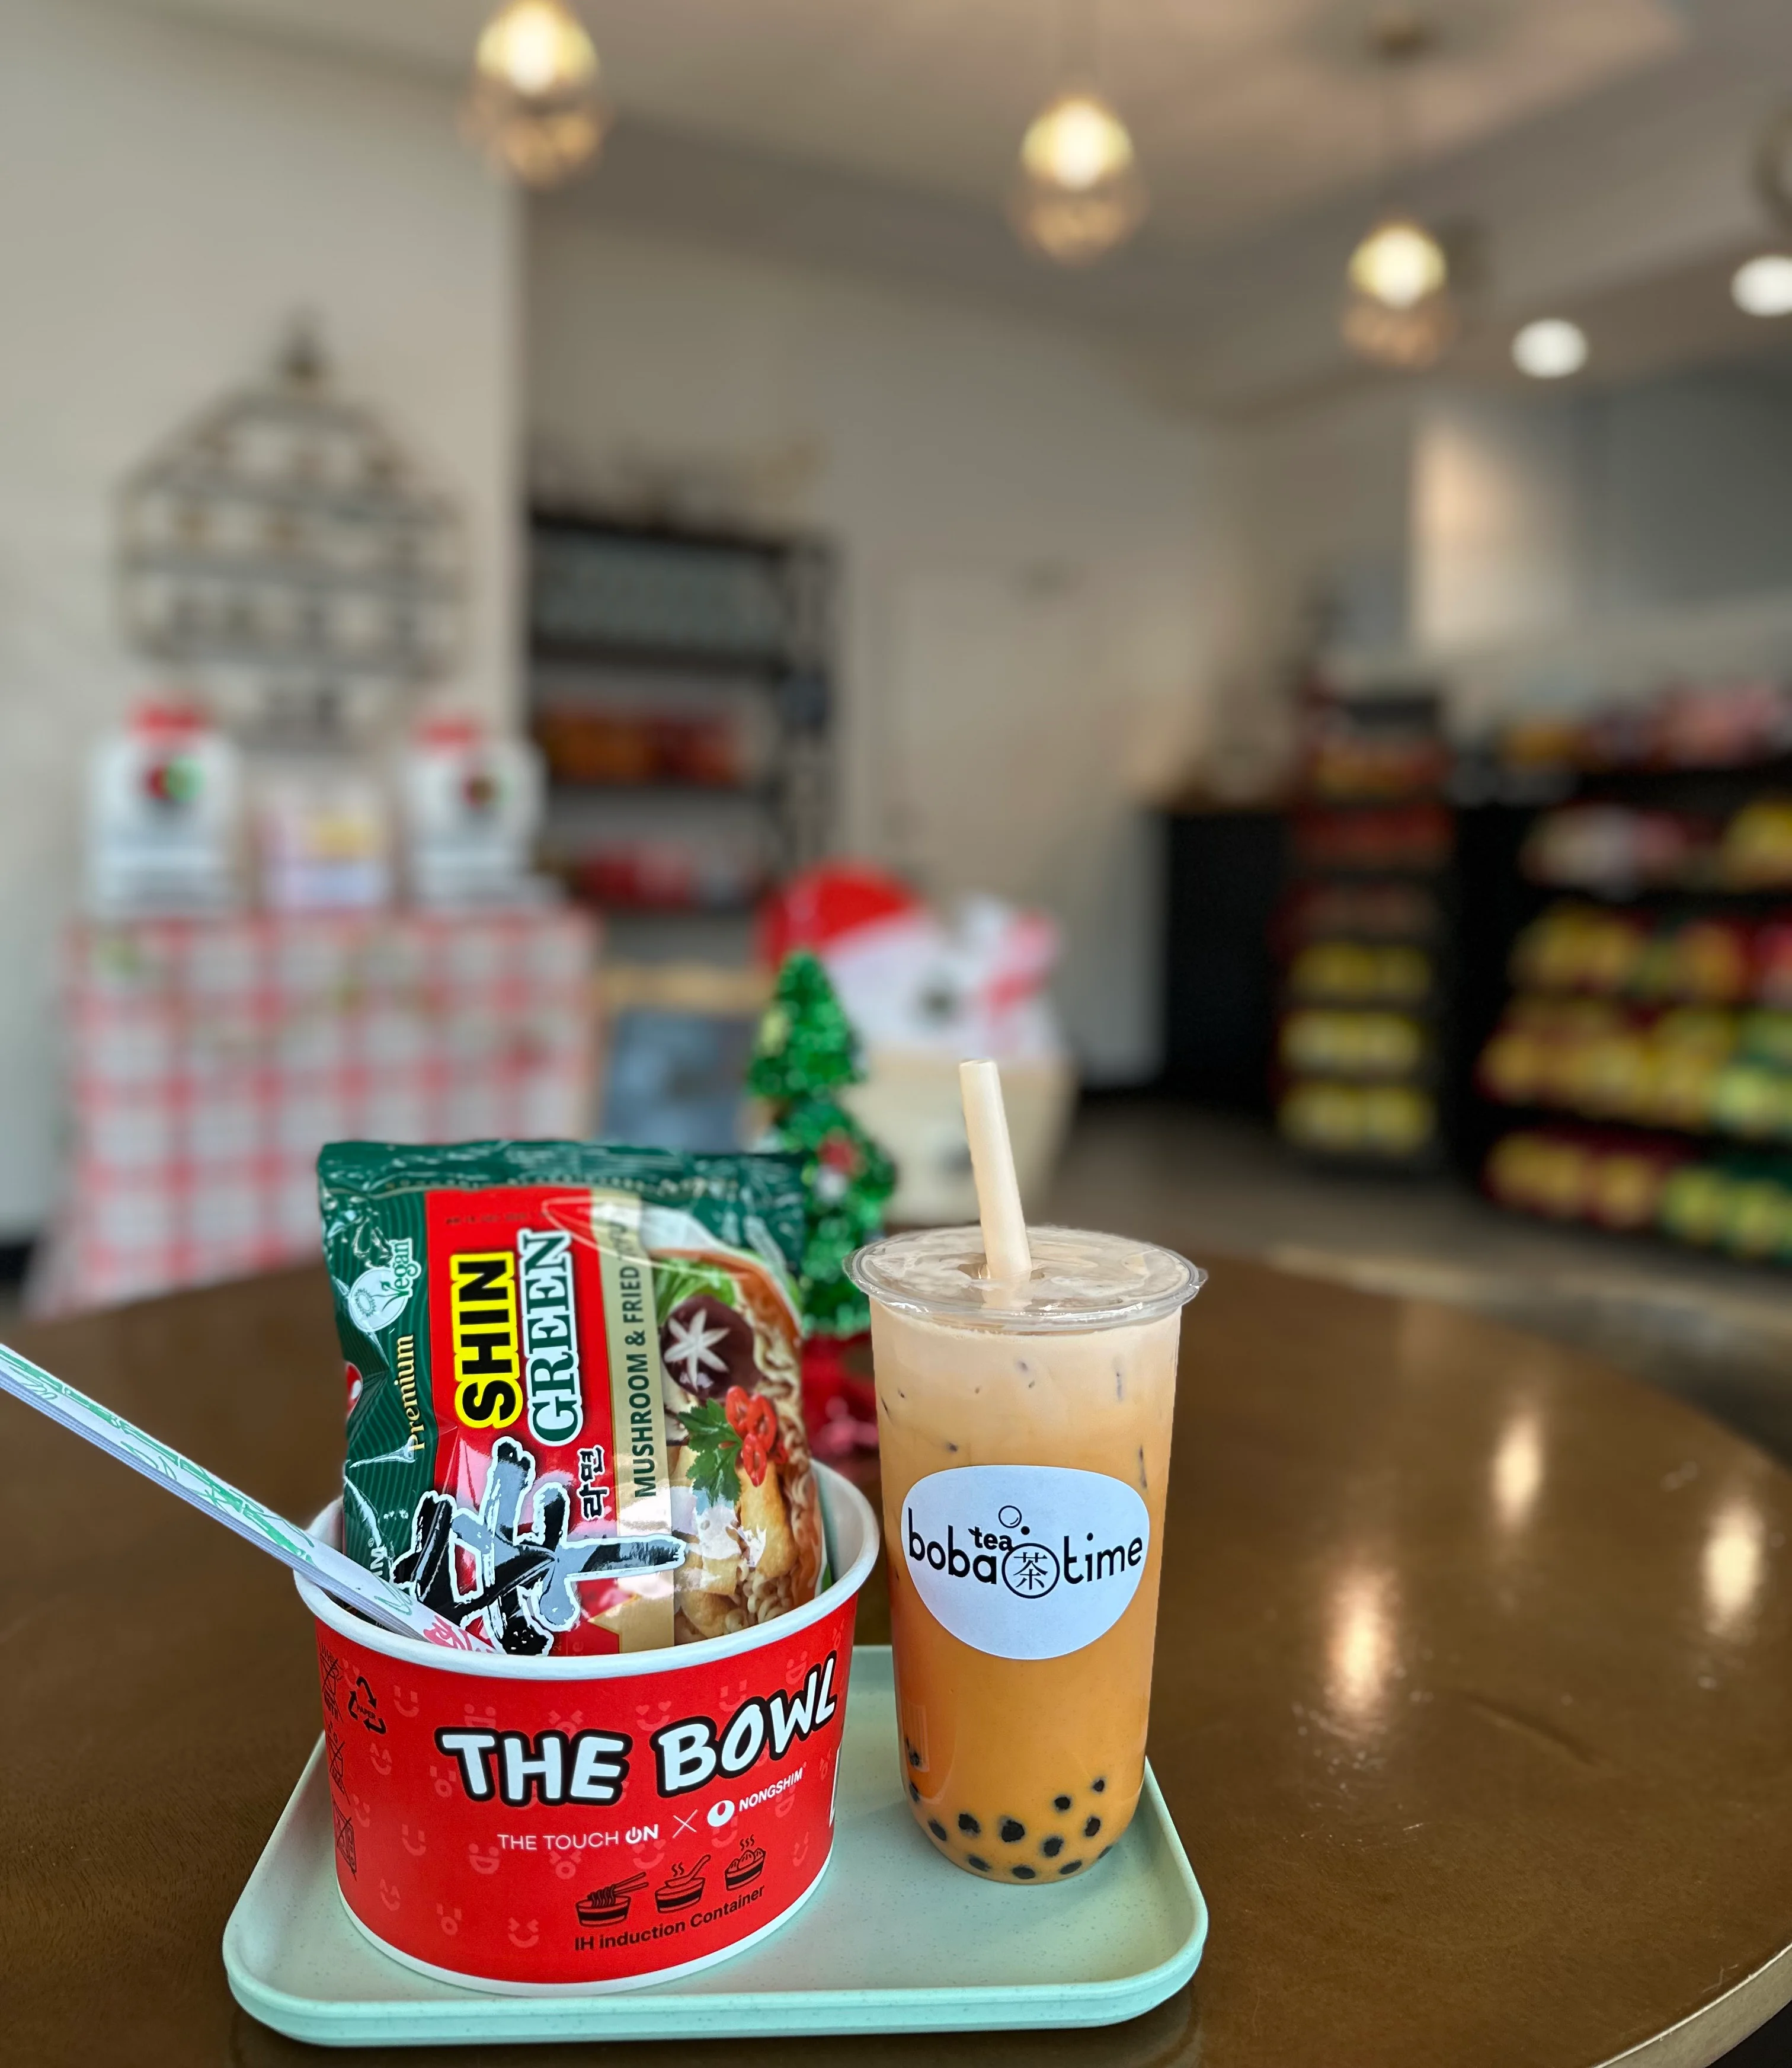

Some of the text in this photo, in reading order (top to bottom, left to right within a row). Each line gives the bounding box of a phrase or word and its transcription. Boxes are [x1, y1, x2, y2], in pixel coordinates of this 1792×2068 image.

[380, 1238, 420, 1297] Vegan
[619, 1266, 644, 1323] FRIED
[452, 1252, 522, 1428] SHIN
[518, 1229, 582, 1446] GREEN
[625, 1330, 645, 1346] &
[394, 1334, 425, 1450] Premium
[626, 1354, 656, 1497] MUSHROOM
[577, 1444, 609, 1522] 라면
[908, 1507, 997, 1584] boba
[968, 1526, 1013, 1552] tea
[1013, 1552, 1048, 1590] 茶
[1064, 1532, 1143, 1584] time
[436, 1650, 837, 1806] THE BOWL
[497, 1833, 537, 1850] THE
[542, 1830, 619, 1850] TOUCH
[738, 1767, 804, 1812] NONGSHIM
[574, 1884, 765, 1951] IH induction Container
